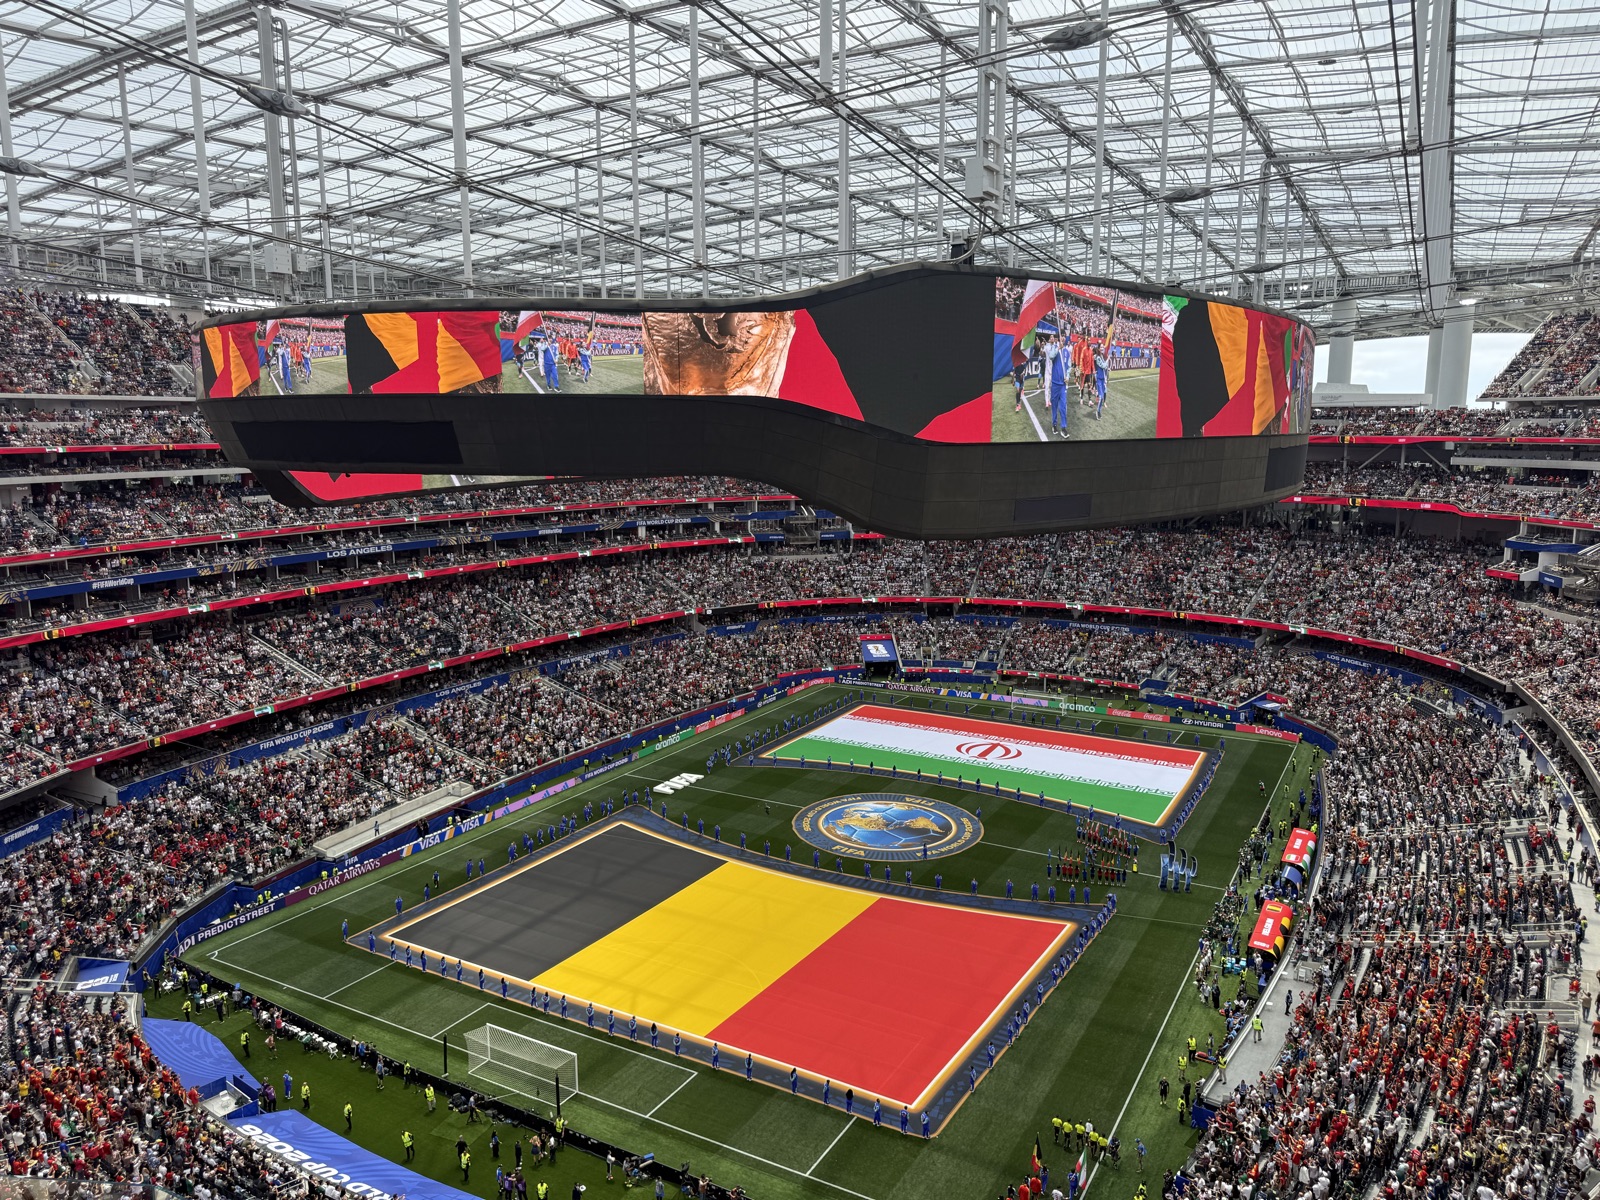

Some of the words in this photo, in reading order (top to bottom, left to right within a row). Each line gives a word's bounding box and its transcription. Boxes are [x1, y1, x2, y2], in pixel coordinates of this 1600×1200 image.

[326, 550, 347, 558] LOS
[349, 544, 393, 556] ANGELES
[92, 578, 134, 590] #FIFAWorldCup
[435, 690, 450, 698] LOS
[887, 683, 908, 691] QATAR
[910, 686, 935, 694] AIRWAYS
[955, 690, 972, 698] VISA
[1059, 702, 1095, 712] aramco
[1194, 720, 1224, 729] HYUNDAI
[260, 741, 275, 750] FIFA
[275, 734, 299, 746] WORLD
[299, 729, 312, 738] CUP
[312, 722, 334, 734] 2026
[1255, 726, 1283, 738] Lenovo
[655, 735, 680, 751] aramco
[652, 772, 705, 795] FIFA
[460, 819, 480, 833] VISA
[419, 834, 440, 850] VISA
[832, 845, 866, 857] FIFA
[345, 855, 359, 866] FIFA
[308, 875, 340, 896] QATAR
[344, 859, 381, 881] AIRWAYS
[178, 935, 196, 957] ADI
[197, 903, 276, 942] PREDICTSTREET
[236, 1124, 312, 1162] 2026
[302, 1161, 351, 1184] CUP
